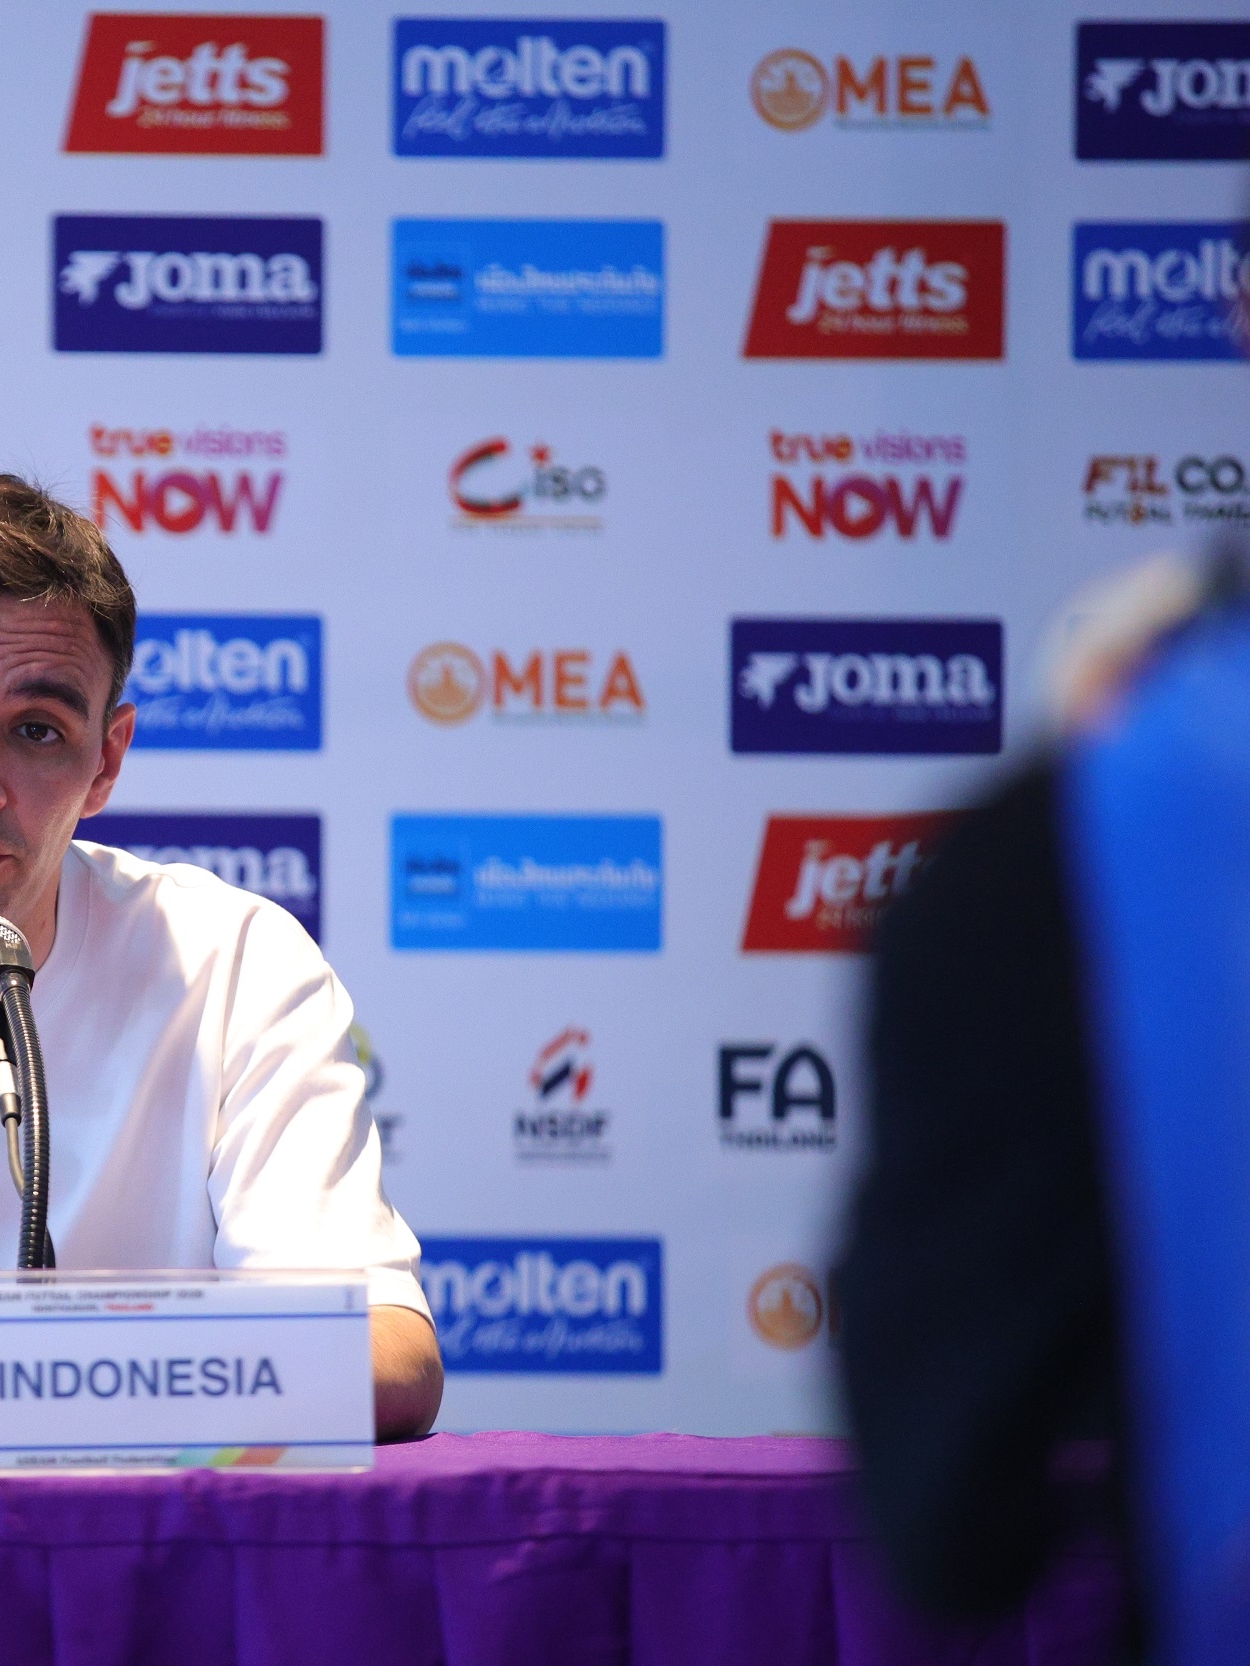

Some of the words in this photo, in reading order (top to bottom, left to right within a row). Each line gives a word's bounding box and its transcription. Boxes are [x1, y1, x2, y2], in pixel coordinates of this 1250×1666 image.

[106, 41, 290, 117] jetts
[402, 36, 649, 98] molten
[835, 55, 990, 116] MEA
[786, 246, 968, 324] jetts
[1083, 239, 1250, 300] molt
[91, 470, 283, 534] NOW
[772, 475, 964, 539] NOW
[135, 629, 308, 693] olten
[491, 651, 645, 711] MEA
[130, 845, 316, 897] ma
[785, 838, 926, 920] jett
[718, 1043, 836, 1121] FA
[421, 1251, 647, 1317] molten
